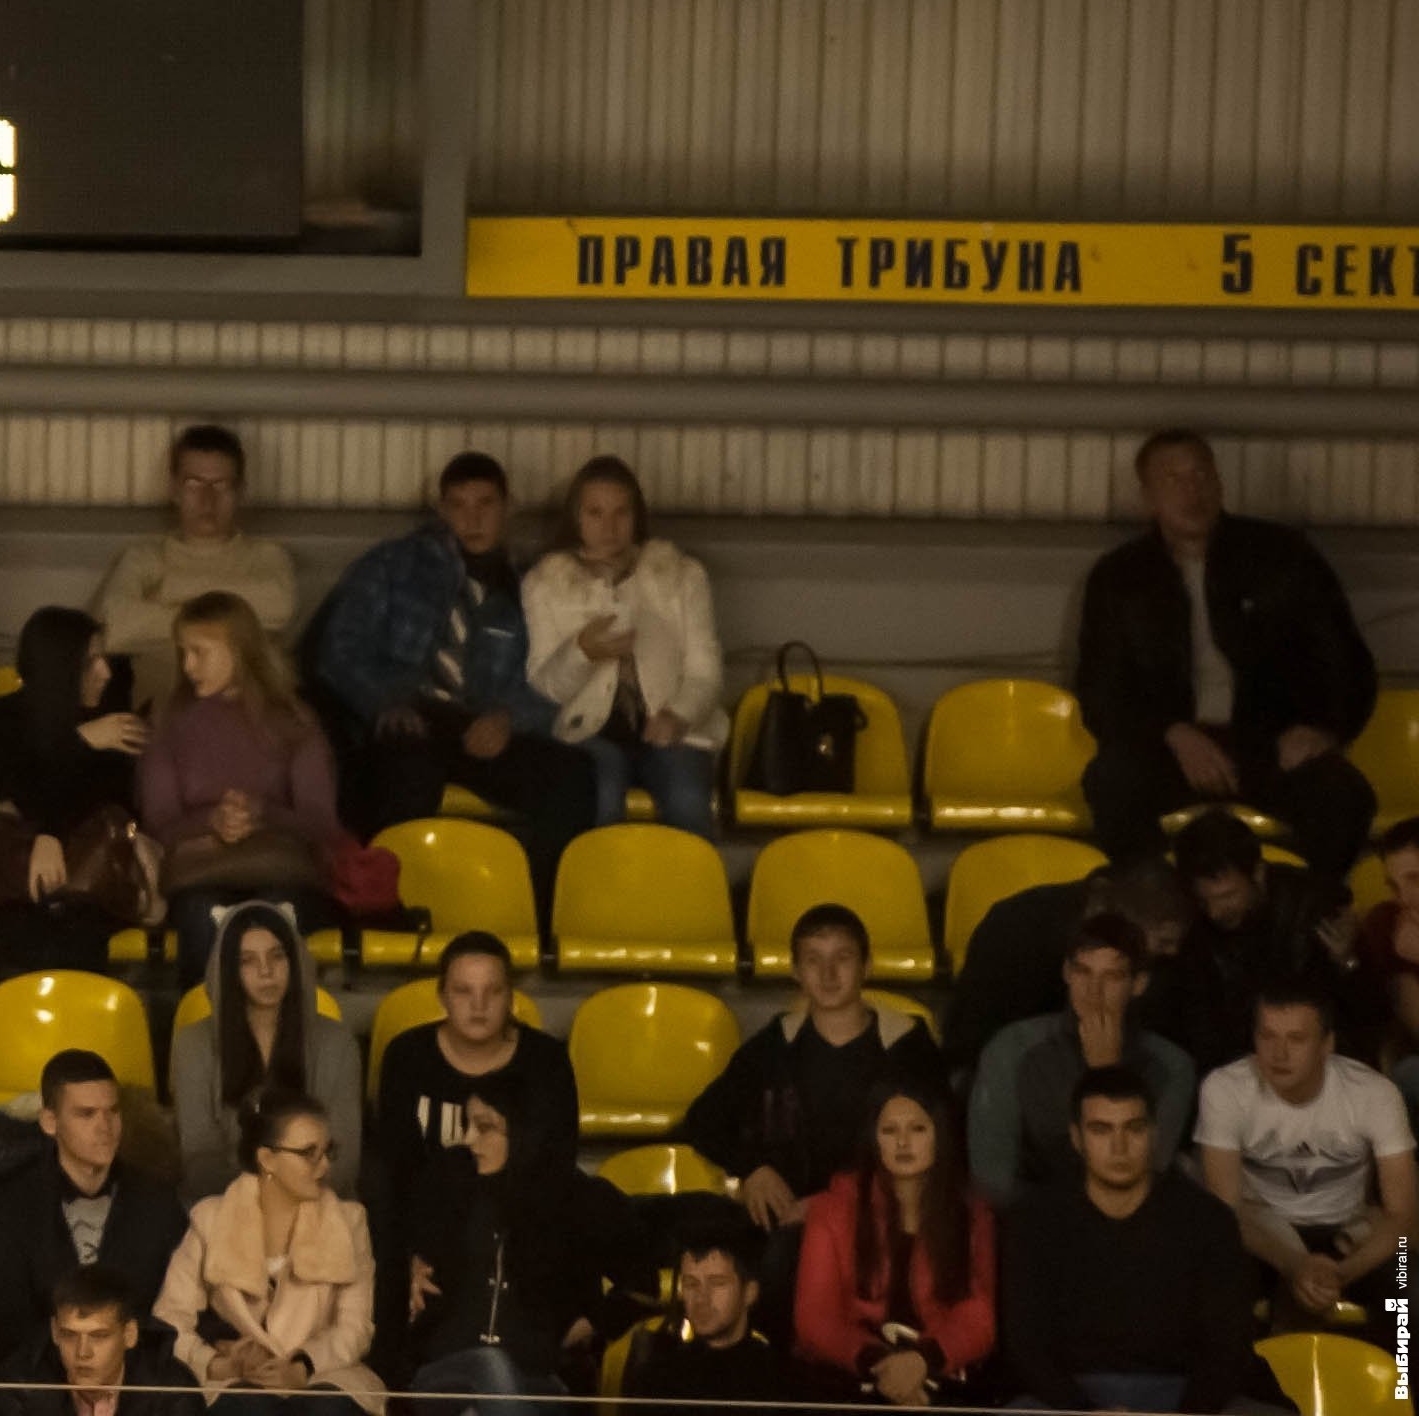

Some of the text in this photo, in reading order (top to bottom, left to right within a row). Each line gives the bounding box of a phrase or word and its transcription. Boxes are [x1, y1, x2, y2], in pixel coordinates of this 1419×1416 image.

[576, 235, 787, 287] ПРАВАЯ
[836, 238, 1082, 293] ТРИБУНА
[1220, 234, 1254, 295] 5
